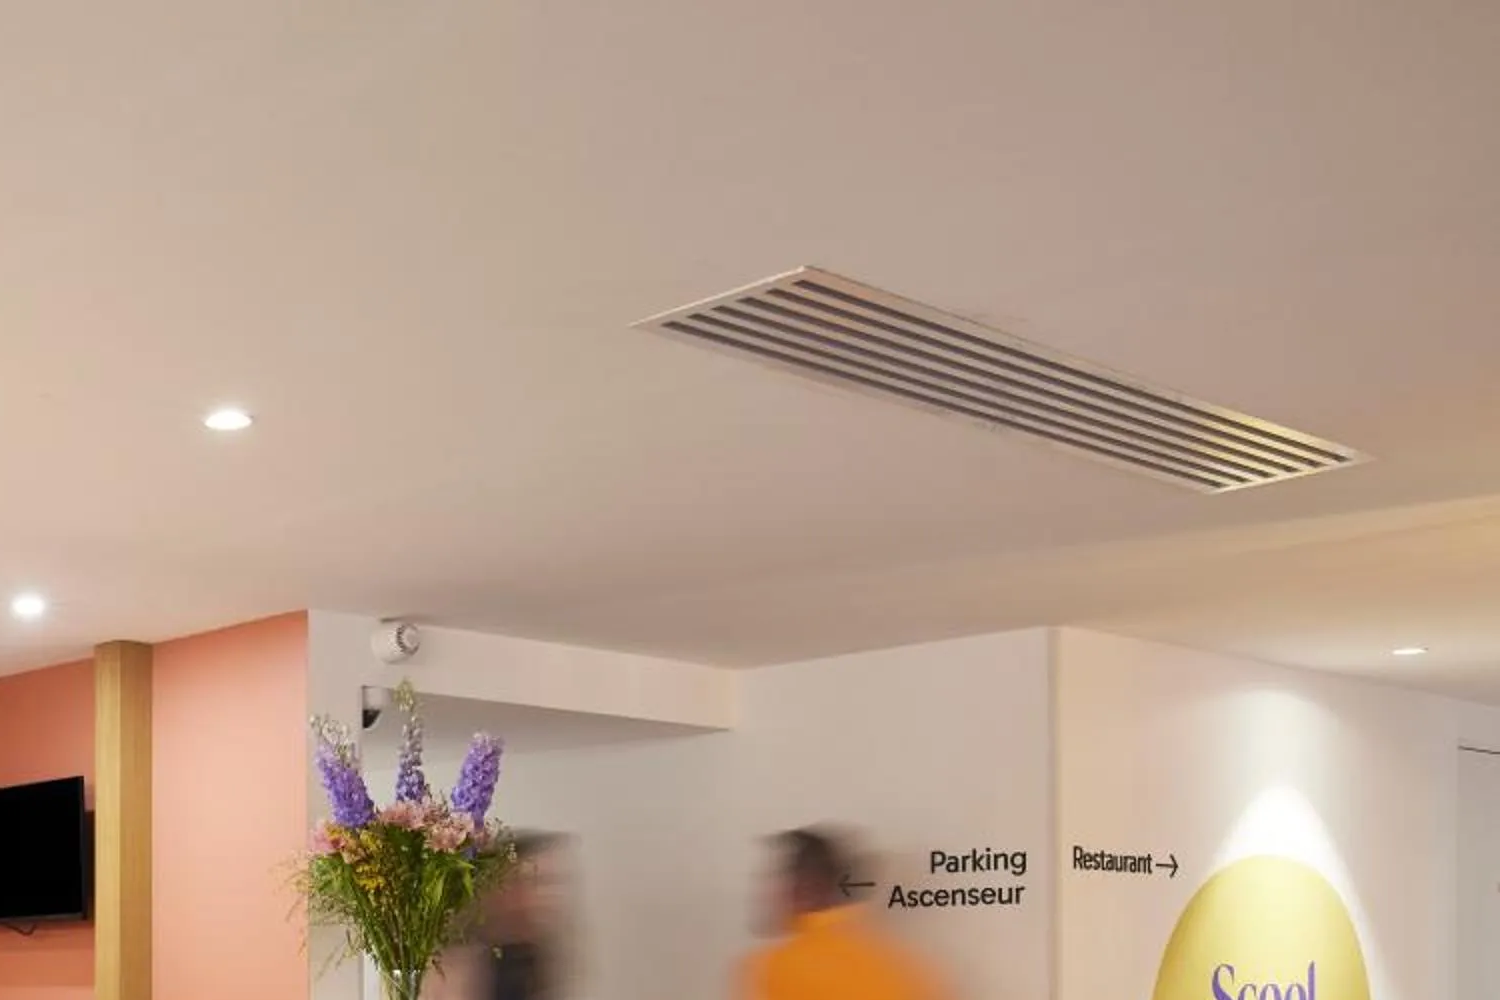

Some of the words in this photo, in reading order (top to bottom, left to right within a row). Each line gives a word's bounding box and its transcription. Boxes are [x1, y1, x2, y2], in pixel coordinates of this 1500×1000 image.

[930, 847, 1028, 876] Parking
[1073, 845, 1154, 875] Restaurant
[888, 885, 1026, 909] Ascenseur
